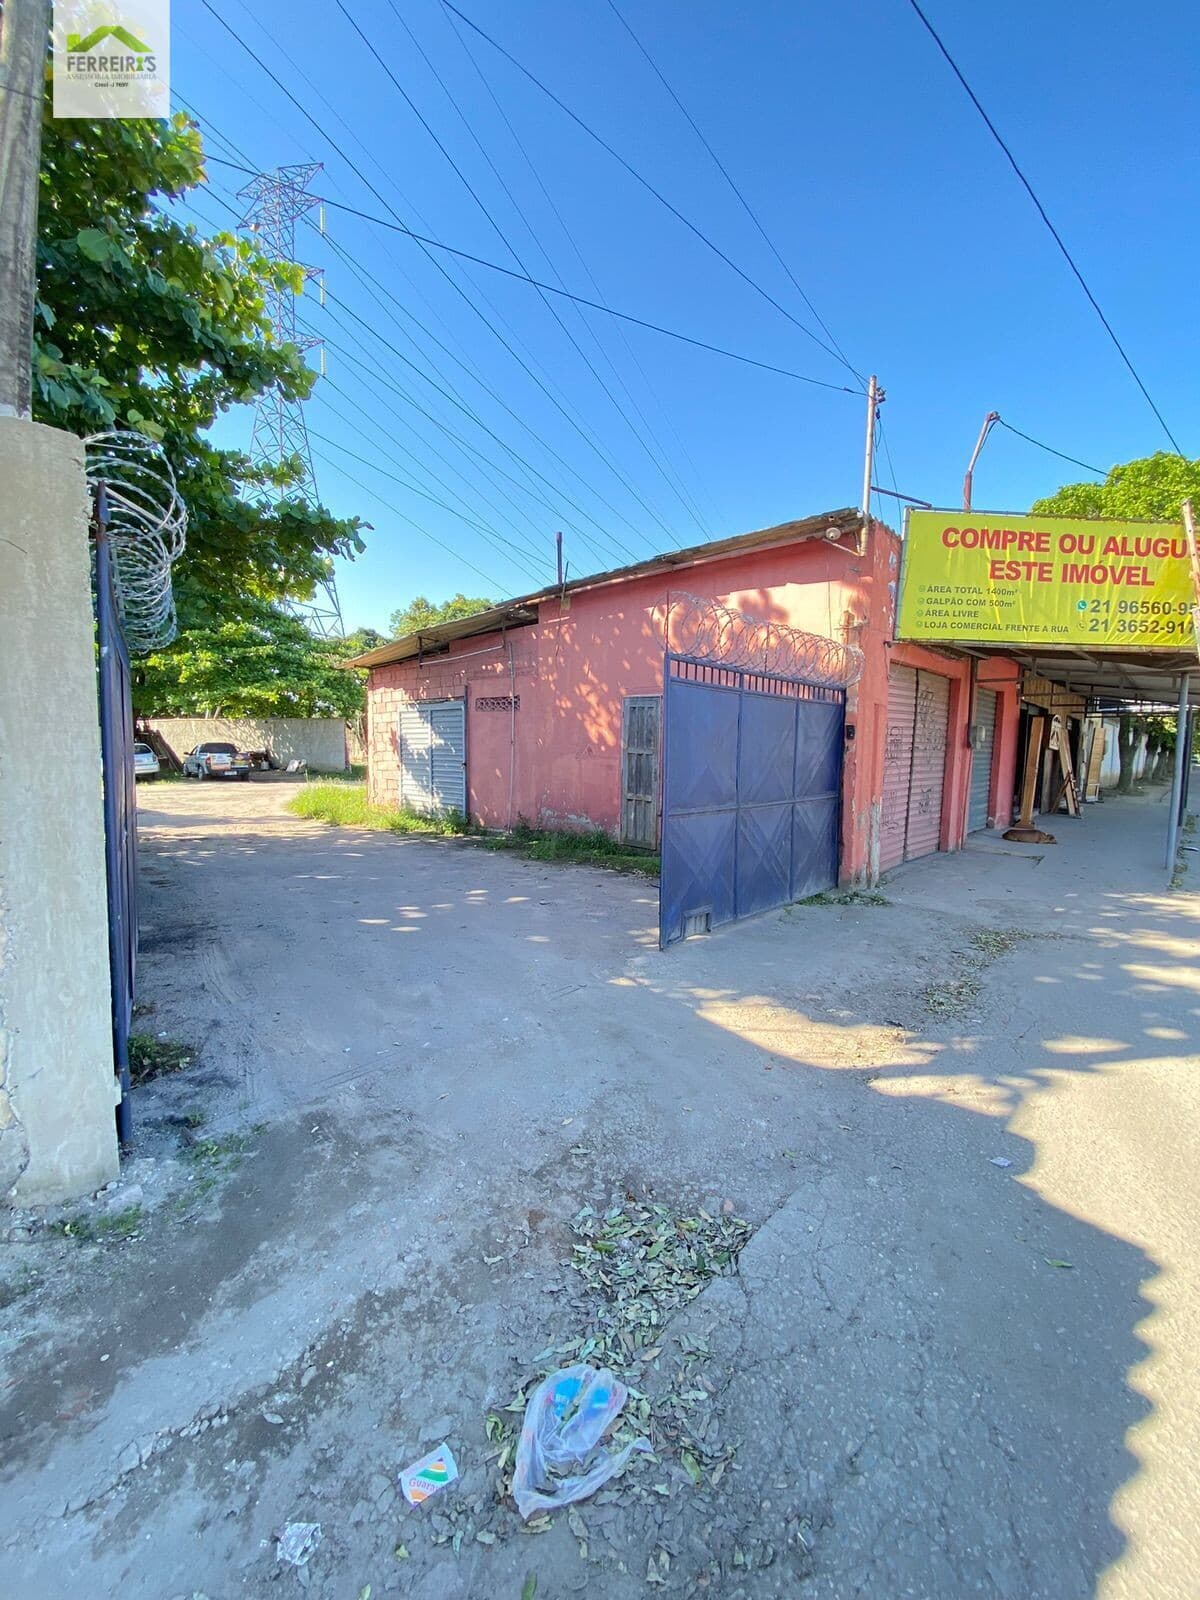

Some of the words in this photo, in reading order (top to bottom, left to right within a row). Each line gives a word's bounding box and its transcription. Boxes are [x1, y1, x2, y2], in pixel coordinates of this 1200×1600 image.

[942, 527, 1051, 552] COMPRE
[1058, 533, 1095, 555] OU
[989, 559, 1053, 582] ESTE
[1061, 560, 1155, 586] IMÓVEL
[954, 586, 983, 594] TOTAL
[926, 597, 963, 606] GALPÃO
[1090, 600, 1111, 613] 21
[952, 610, 979, 618] LIVRE
[924, 621, 948, 629] LOJA
[950, 622, 1003, 631] COMERCIAL
[1005, 624, 1040, 632] FRENTE
[1051, 625, 1069, 633] RUA
[1089, 618, 1109, 632] 21
